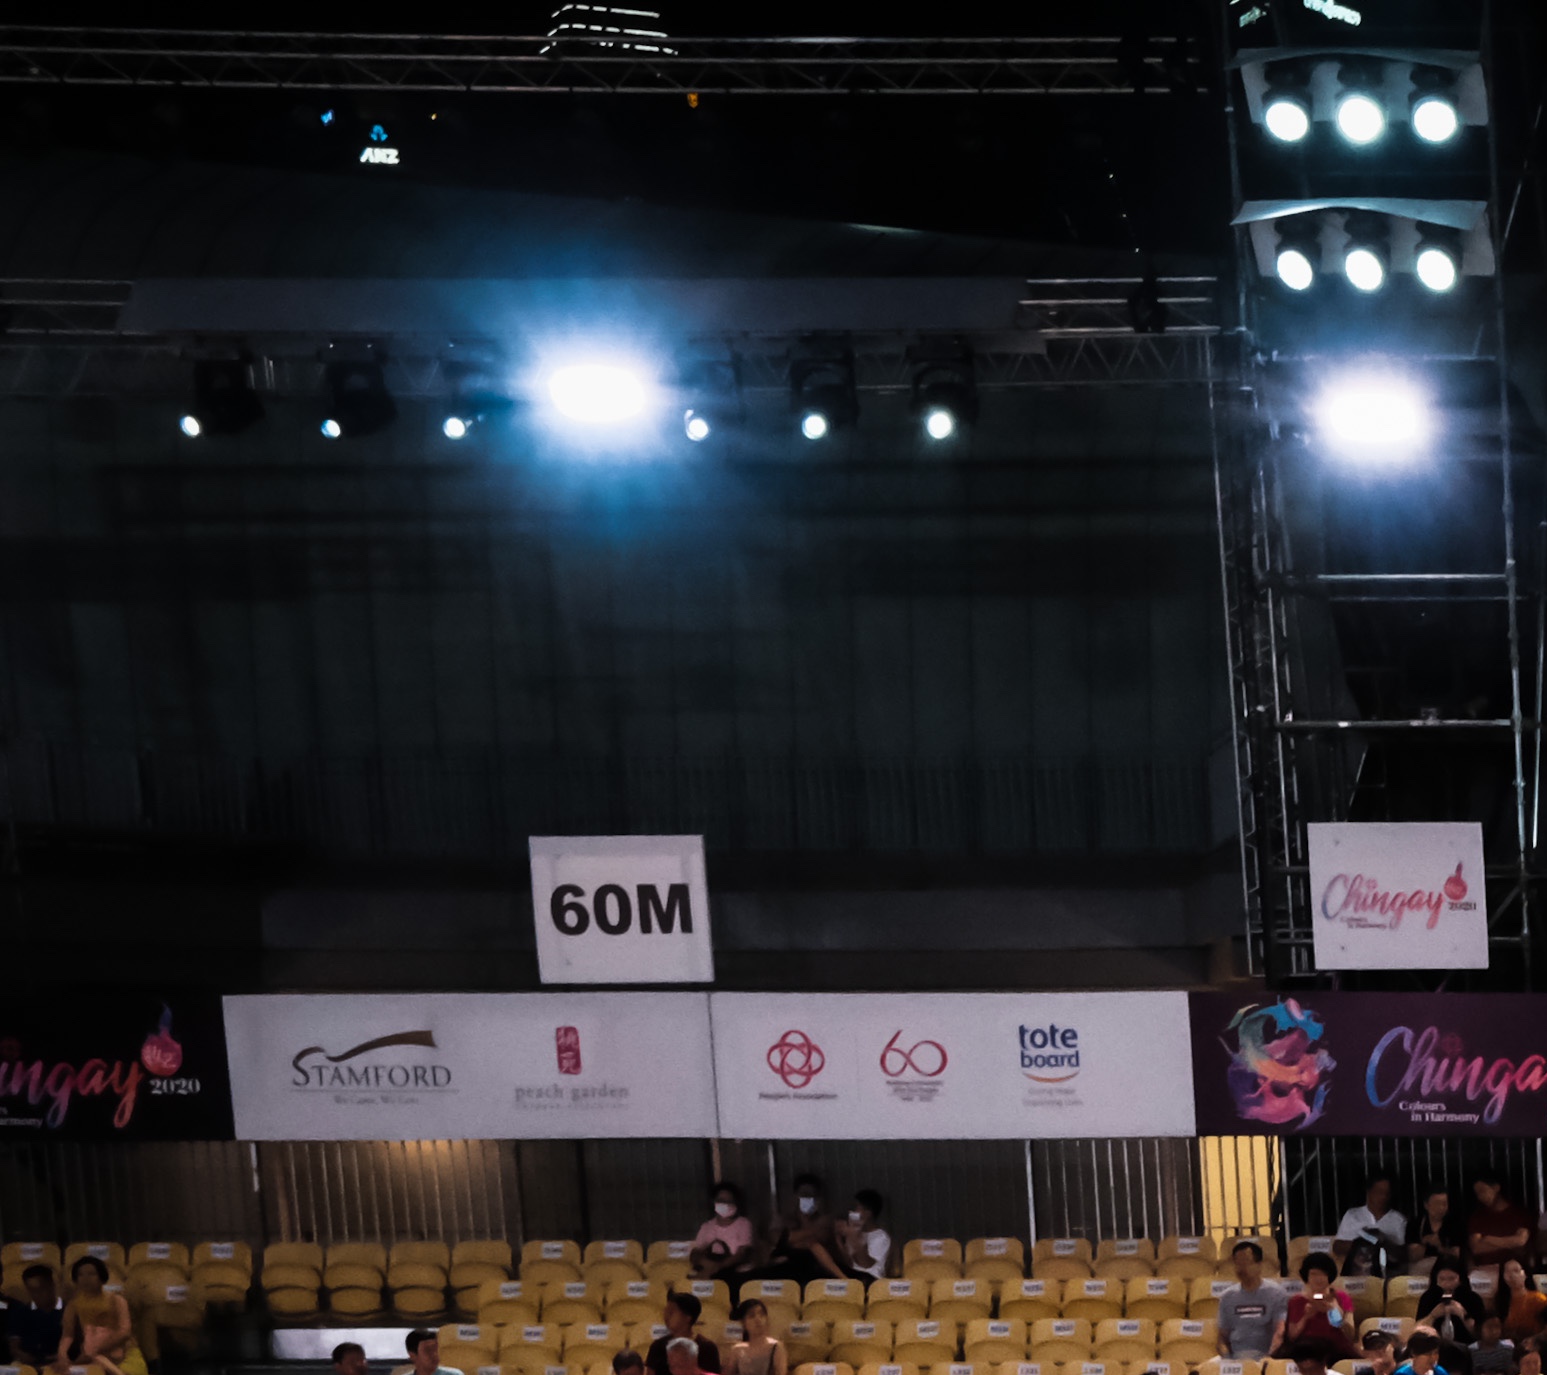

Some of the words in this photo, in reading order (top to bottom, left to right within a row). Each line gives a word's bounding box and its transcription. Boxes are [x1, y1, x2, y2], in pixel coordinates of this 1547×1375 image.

[551, 883, 695, 936] 60M
[1321, 873, 1444, 930] Chingay
[1019, 1023, 1078, 1050] tote
[1020, 1050, 1080, 1068] board
[149, 1078, 201, 1095] 2020
[515, 1083, 563, 1102] peach
[571, 1083, 630, 1102] garden
